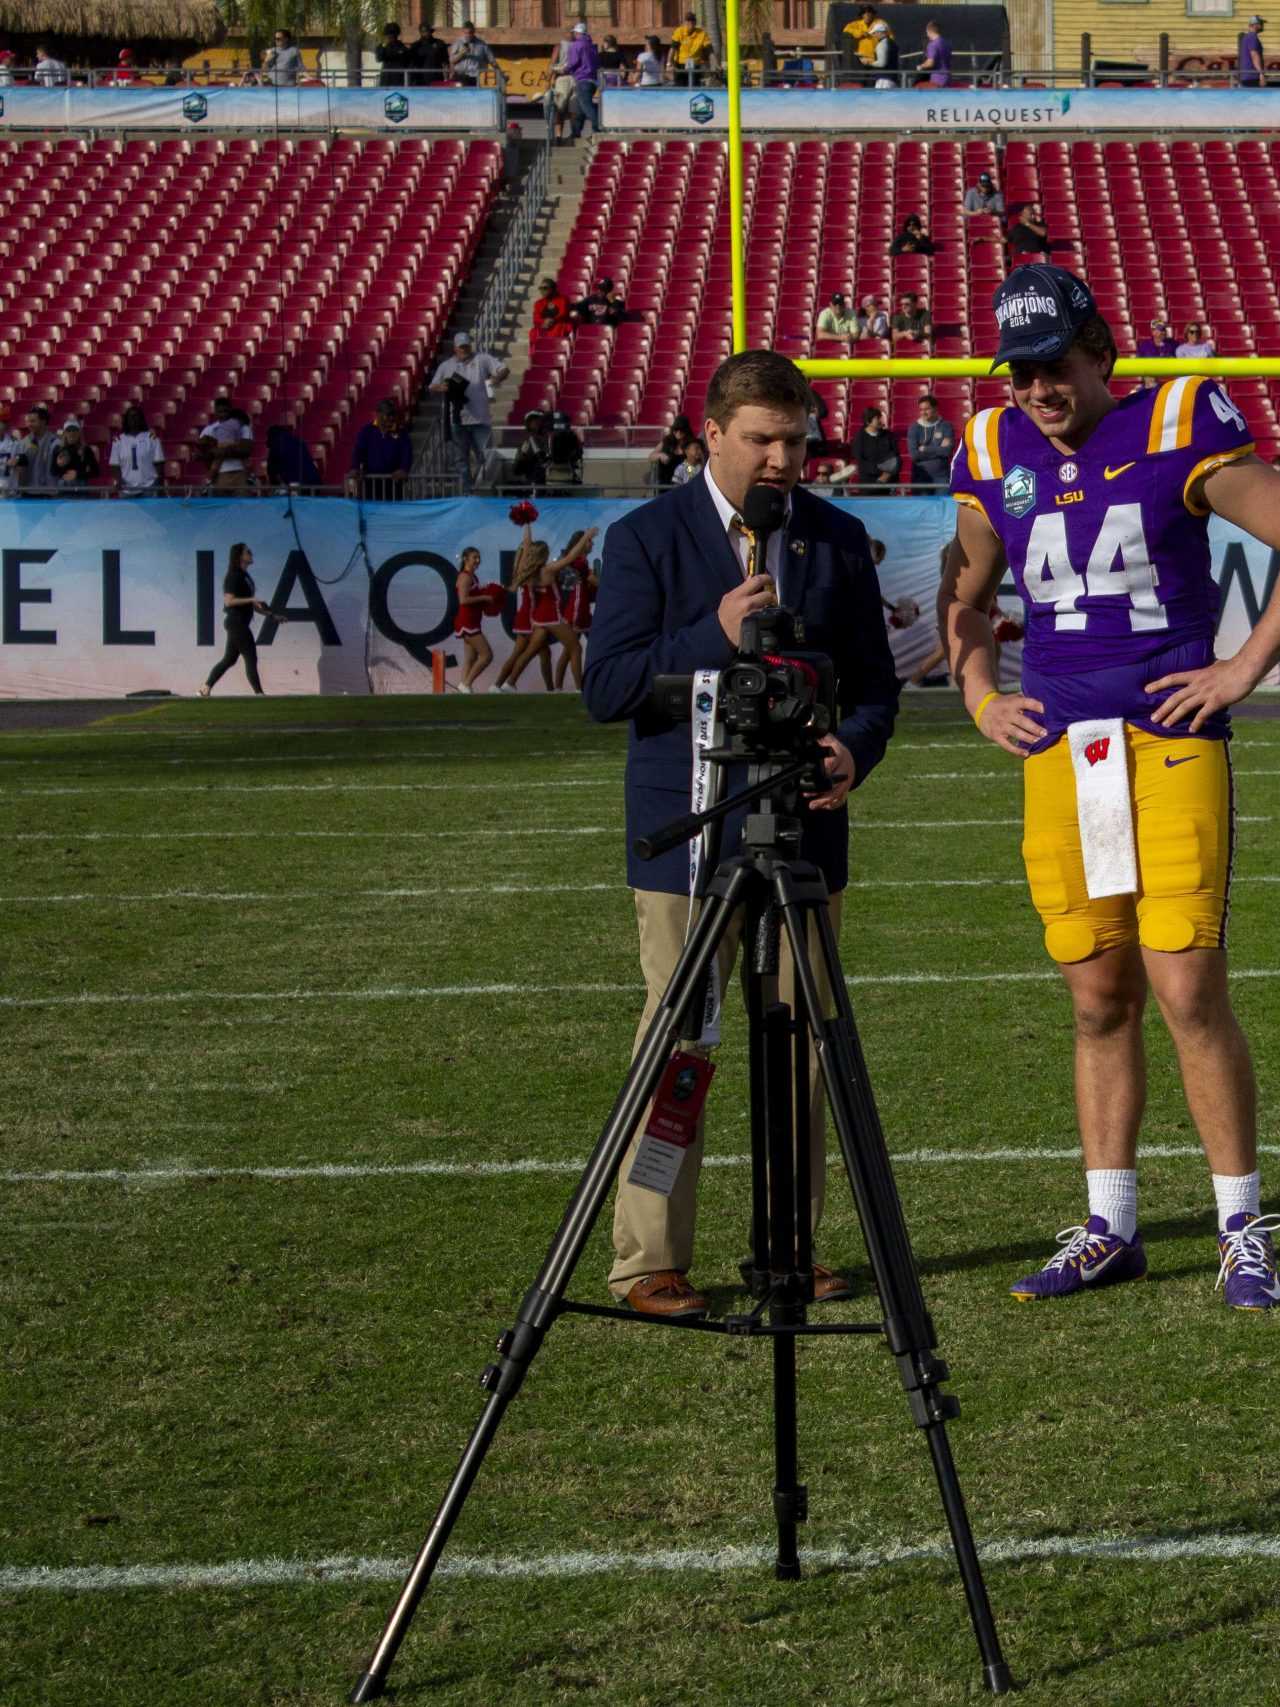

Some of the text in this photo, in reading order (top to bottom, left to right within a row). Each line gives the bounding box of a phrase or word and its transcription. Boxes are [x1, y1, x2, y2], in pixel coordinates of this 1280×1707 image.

[926, 108, 1055, 124] RELIAQUEST
[1009, 315, 1032, 328] 2024
[1059, 463, 1079, 483] SEC
[1055, 489, 1085, 506] LSU
[1023, 503, 1170, 633] 44
[1084, 736, 1111, 768] W
